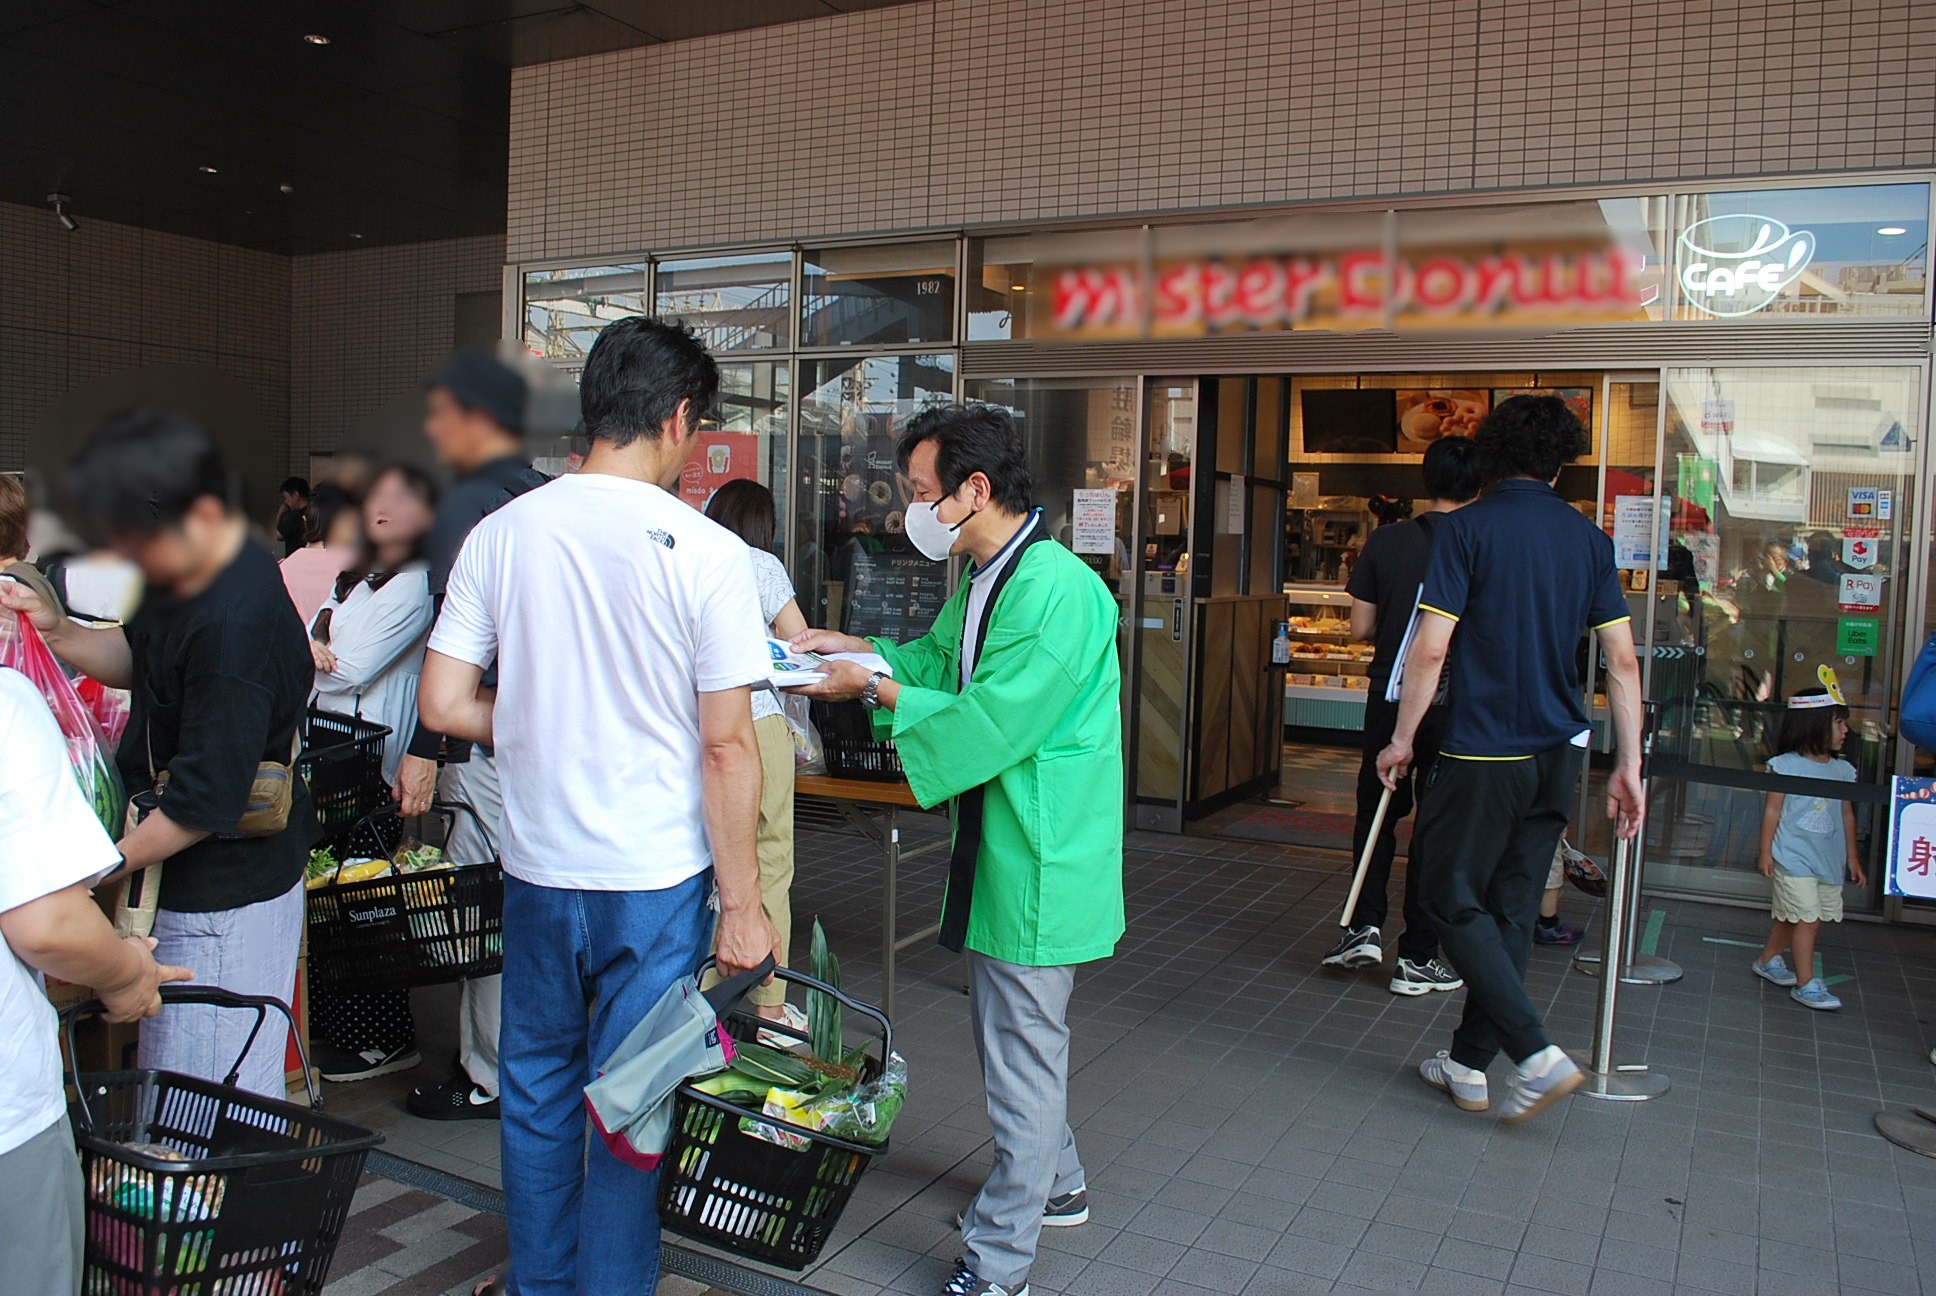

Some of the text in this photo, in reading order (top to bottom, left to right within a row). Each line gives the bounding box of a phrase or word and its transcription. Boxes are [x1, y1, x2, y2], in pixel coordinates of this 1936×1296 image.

[1682, 260, 1785, 297] CAFE
[1053, 259, 1332, 328] mster
[686, 486, 706, 495] misdo
[1851, 491, 1875, 500] VISA
[646, 529, 666, 541] NORTH
[657, 528, 668, 536] THE
[649, 534, 665, 545] FACE
[890, 558, 937, 567] ドリンクメニュー
[1851, 555, 1868, 564] Pay
[1847, 629, 1867, 637] Uber
[1847, 637, 1867, 645] Eats
[349, 906, 397, 922] Sunplaza
